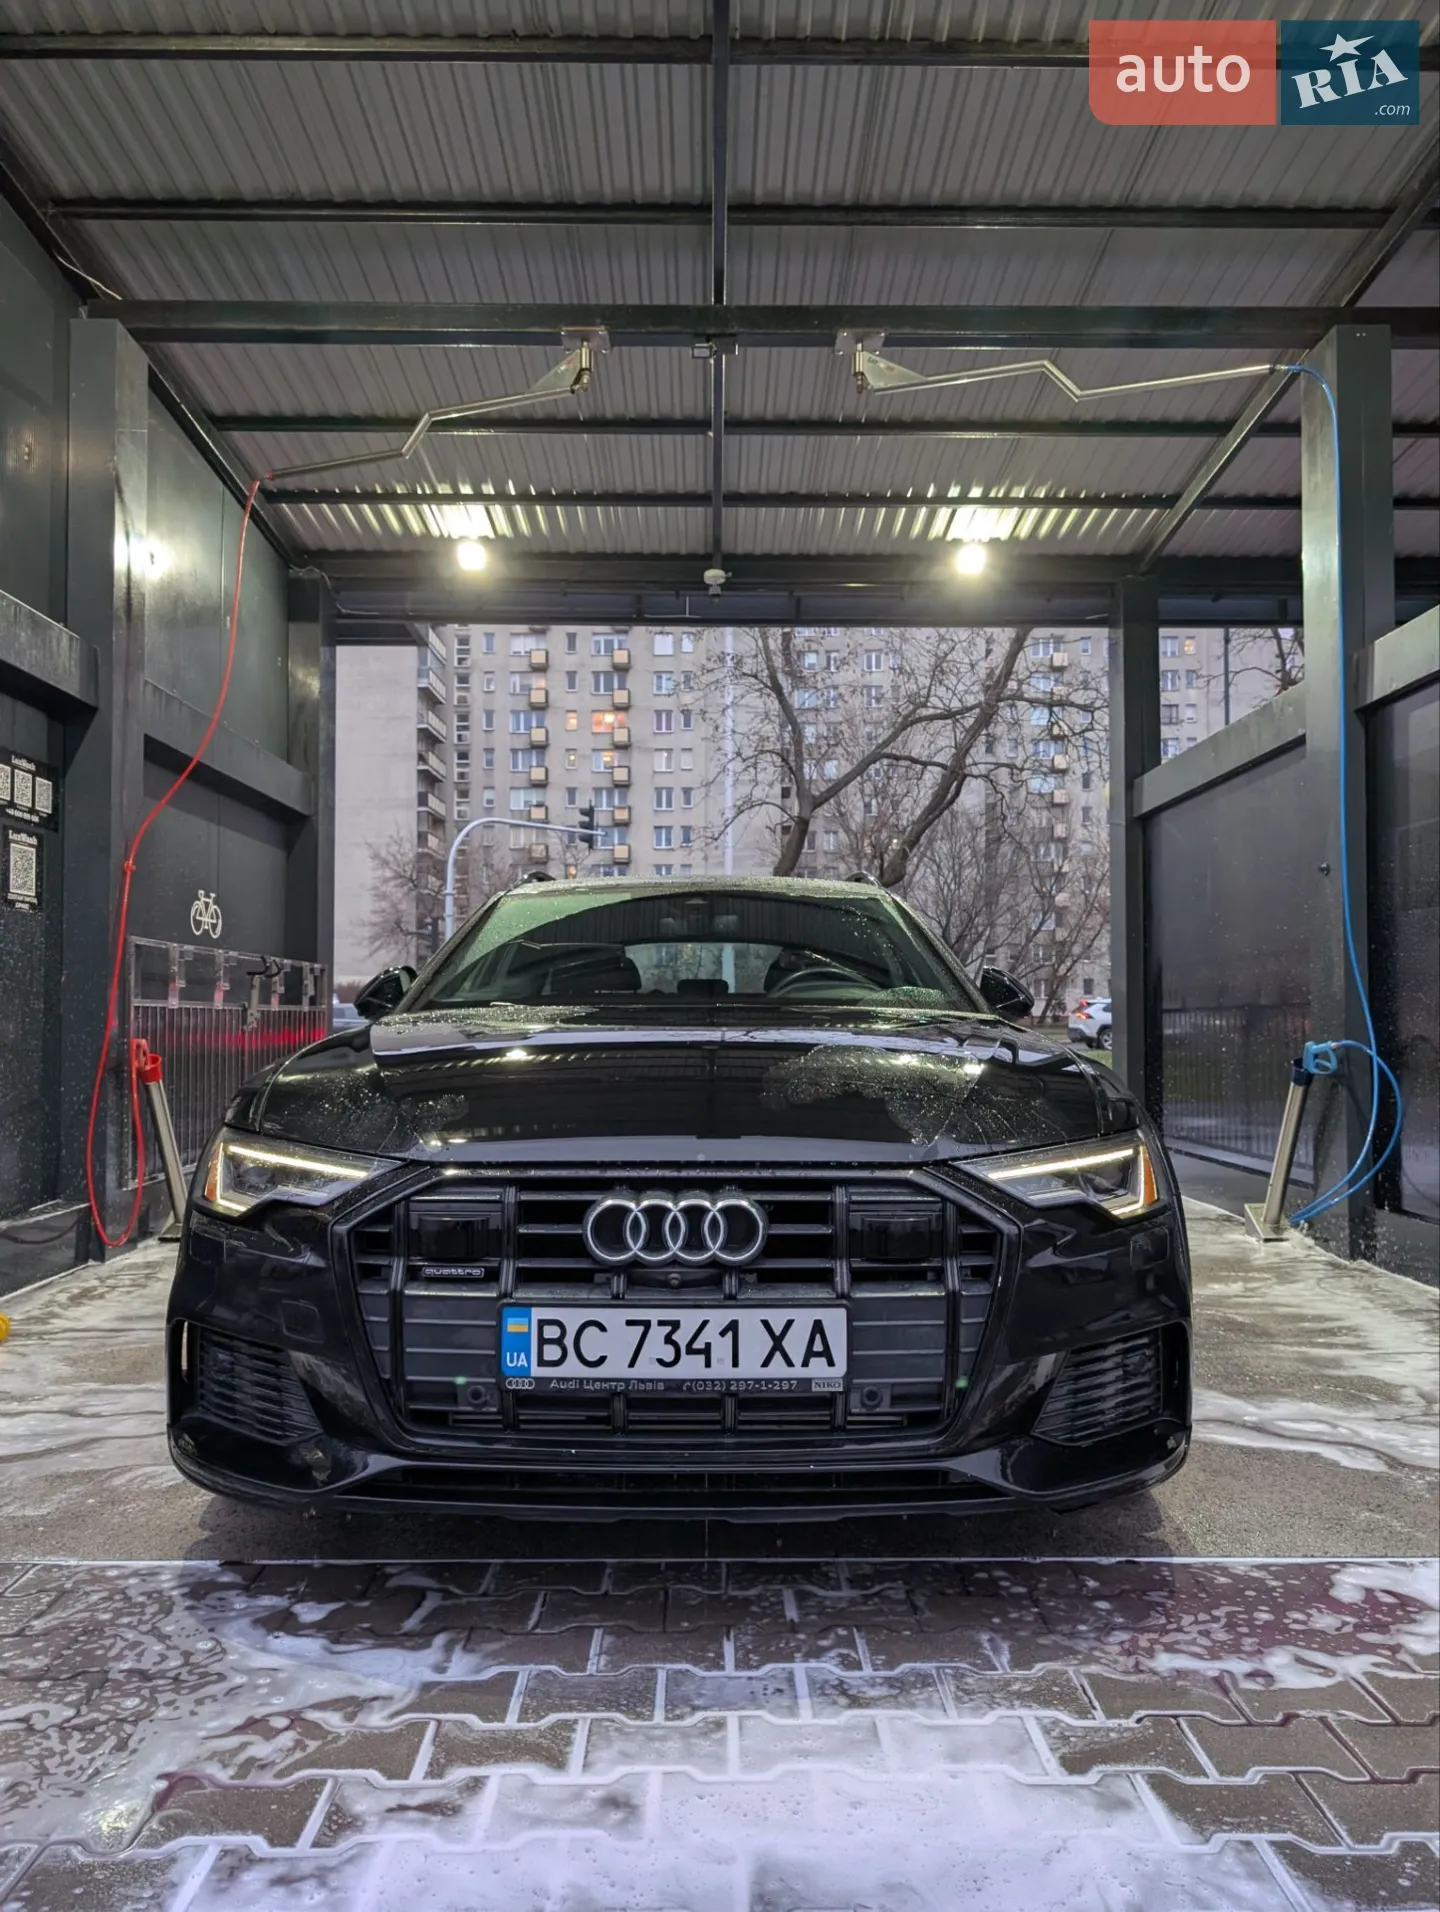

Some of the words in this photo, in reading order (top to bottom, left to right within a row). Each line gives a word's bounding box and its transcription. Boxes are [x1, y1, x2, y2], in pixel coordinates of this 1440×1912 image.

[424, 1268, 481, 1276] quattro
[536, 1318, 608, 1369] BC
[625, 1318, 740, 1369] 7341
[760, 1318, 836, 1369] XA
[506, 1353, 528, 1369] UA
[549, 1379, 580, 1389] Audi
[583, 1380, 625, 1391] Центр
[628, 1380, 665, 1390] Львів
[730, 1380, 798, 1390] 297-1-297
[814, 1381, 842, 1389] NIKO
